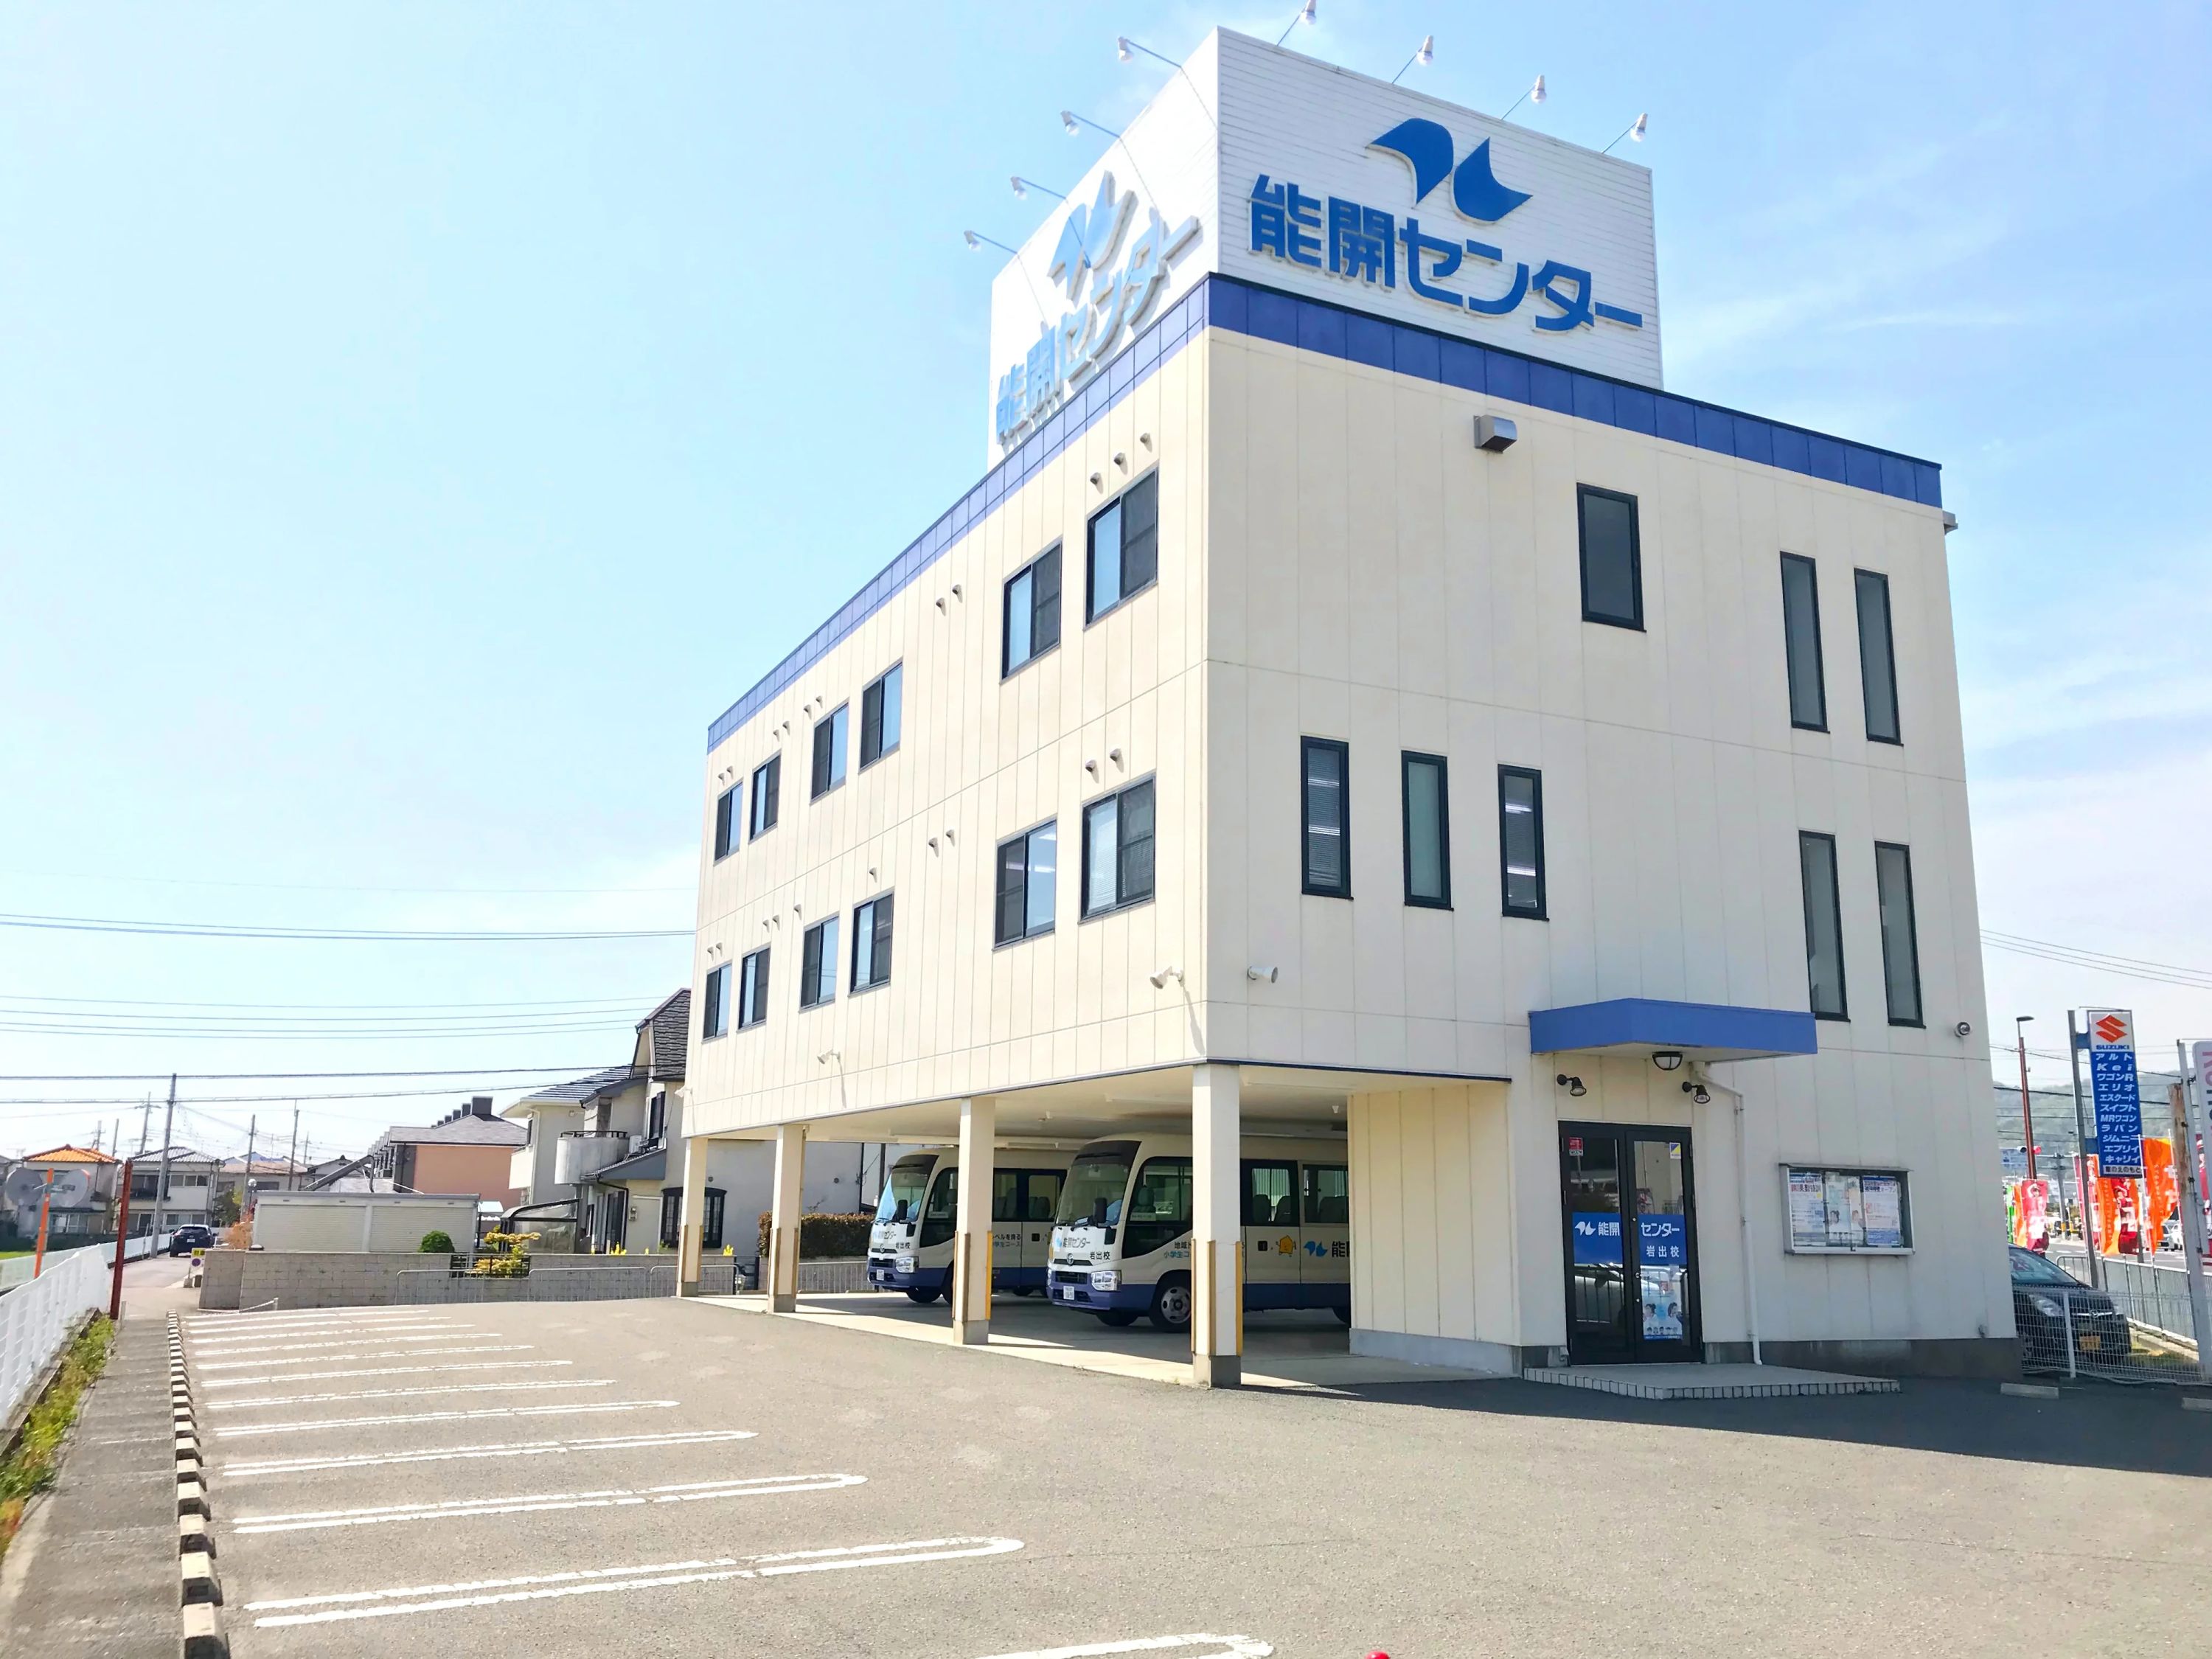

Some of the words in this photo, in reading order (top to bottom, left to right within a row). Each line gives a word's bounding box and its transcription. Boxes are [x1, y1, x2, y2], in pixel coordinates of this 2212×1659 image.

[1248, 173, 1644, 334] 能開センター
[995, 206, 1203, 445] 能開センター
[2096, 1053, 2133, 1061] アルト
[2096, 1062, 2133, 1071] Kei
[2097, 1073, 2134, 1082] ワゴンR
[2098, 1083, 2135, 1091] エリオ
[2100, 1104, 2137, 1112] スイフト
[2100, 1114, 2137, 1122] MRワゴン
[2101, 1124, 2138, 1133] ラバン
[1597, 1222, 1621, 1237] 能開
[1641, 1222, 1680, 1237] センター
[1090, 1251, 1110, 1260] 岩出校
[1646, 1245, 1680, 1258] 岩出校
